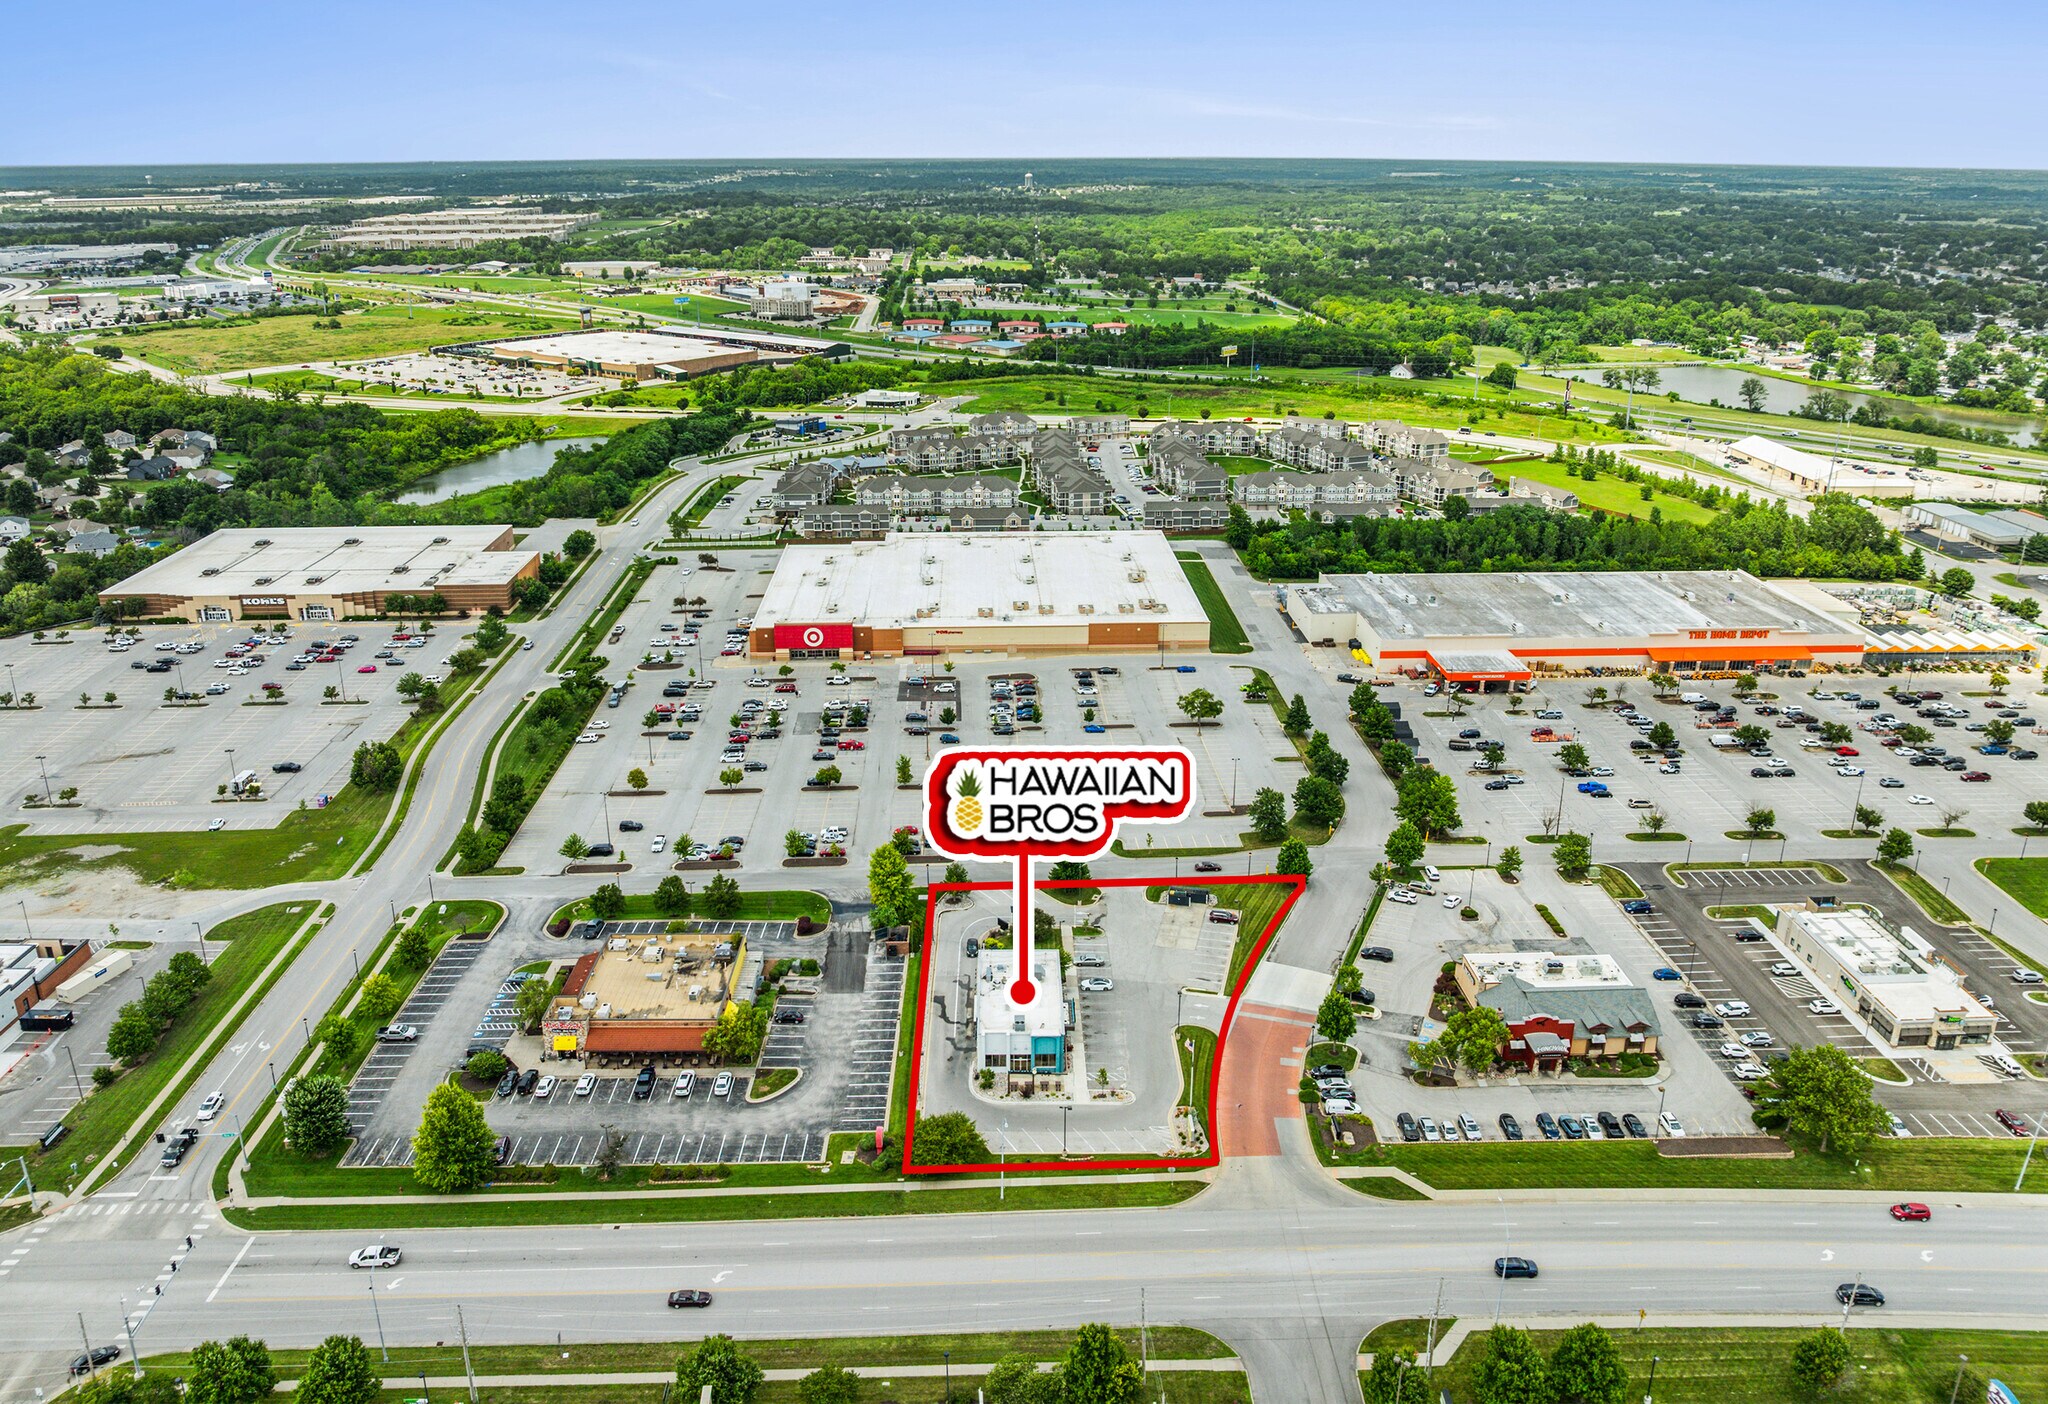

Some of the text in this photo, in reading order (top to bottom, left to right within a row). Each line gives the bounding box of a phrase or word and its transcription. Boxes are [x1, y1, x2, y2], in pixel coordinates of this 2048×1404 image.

[1688, 630, 1770, 639] THE HOME DEPOT
